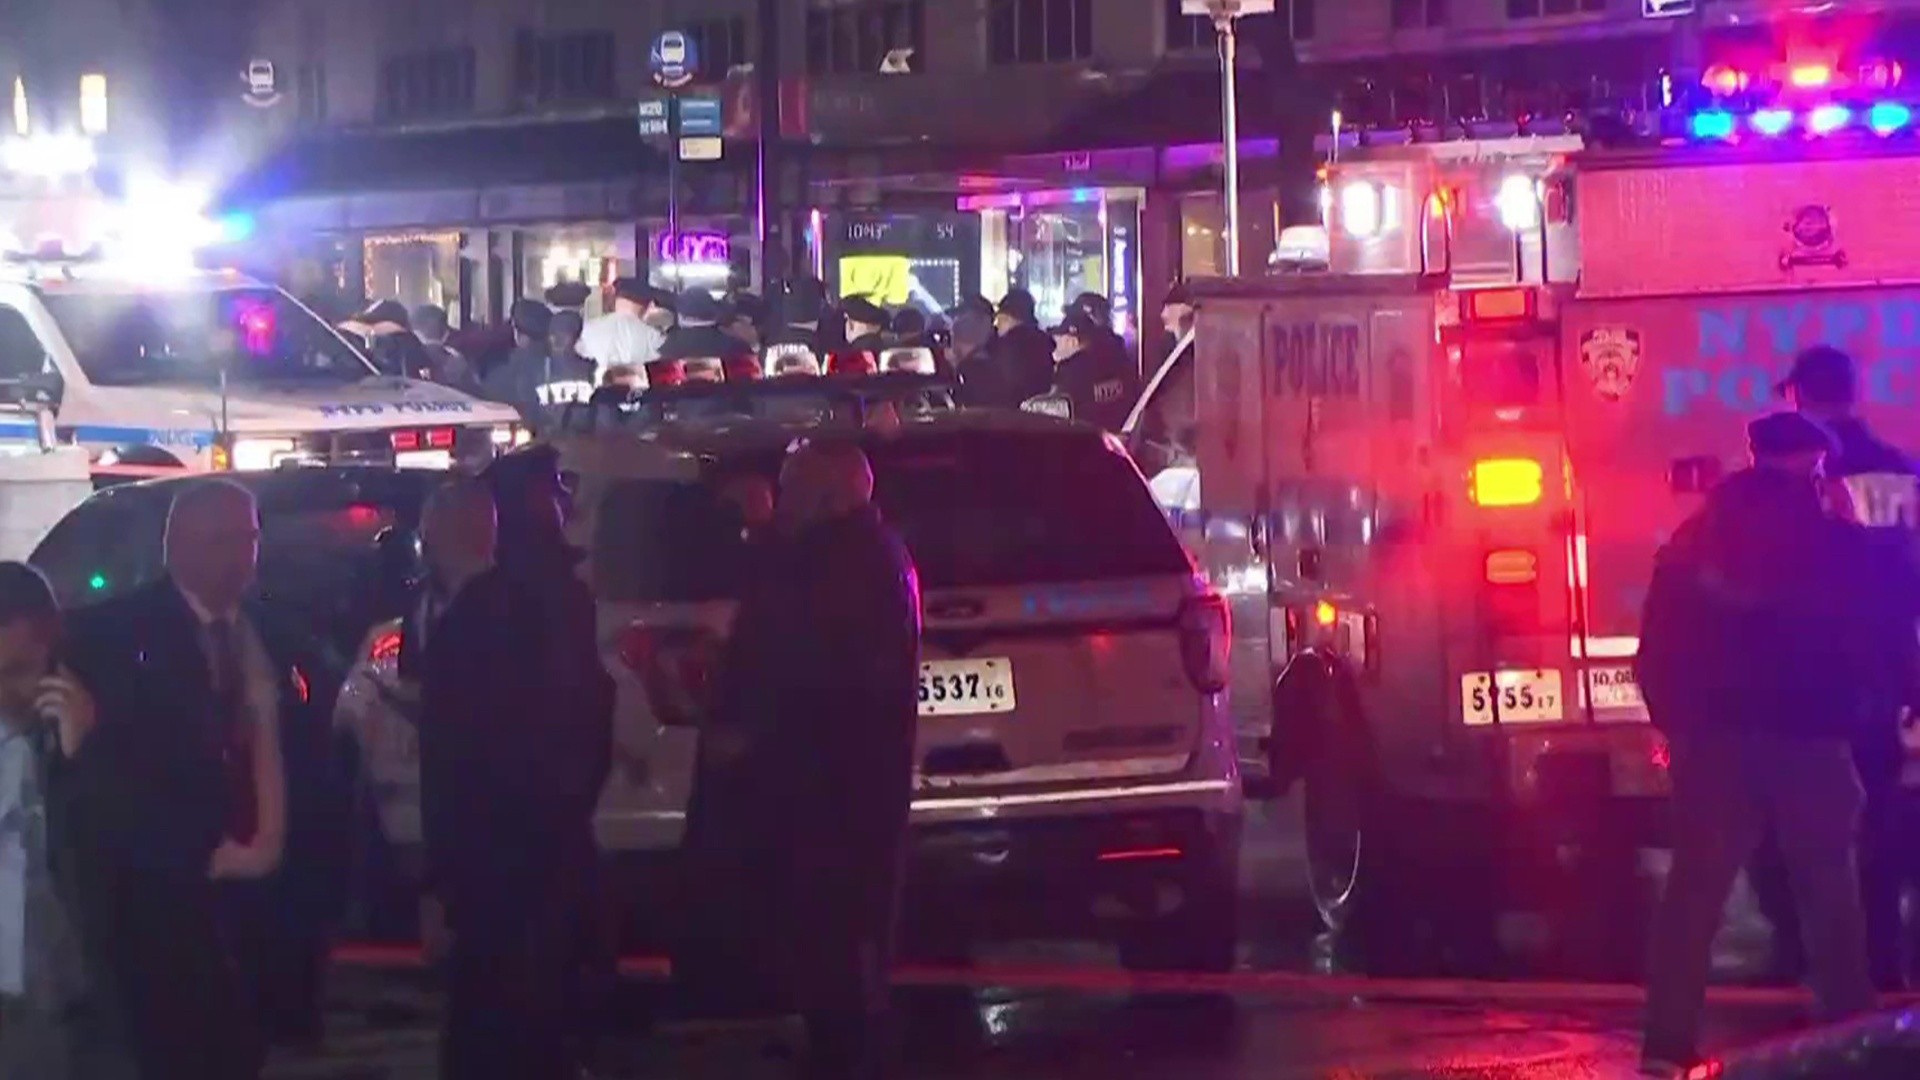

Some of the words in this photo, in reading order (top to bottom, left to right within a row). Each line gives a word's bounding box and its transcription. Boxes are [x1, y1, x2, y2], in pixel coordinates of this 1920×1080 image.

[1698, 301, 1920, 358] NYPD
[1273, 322, 1359, 396] POLICE
[535, 380, 593, 407] NYPD
